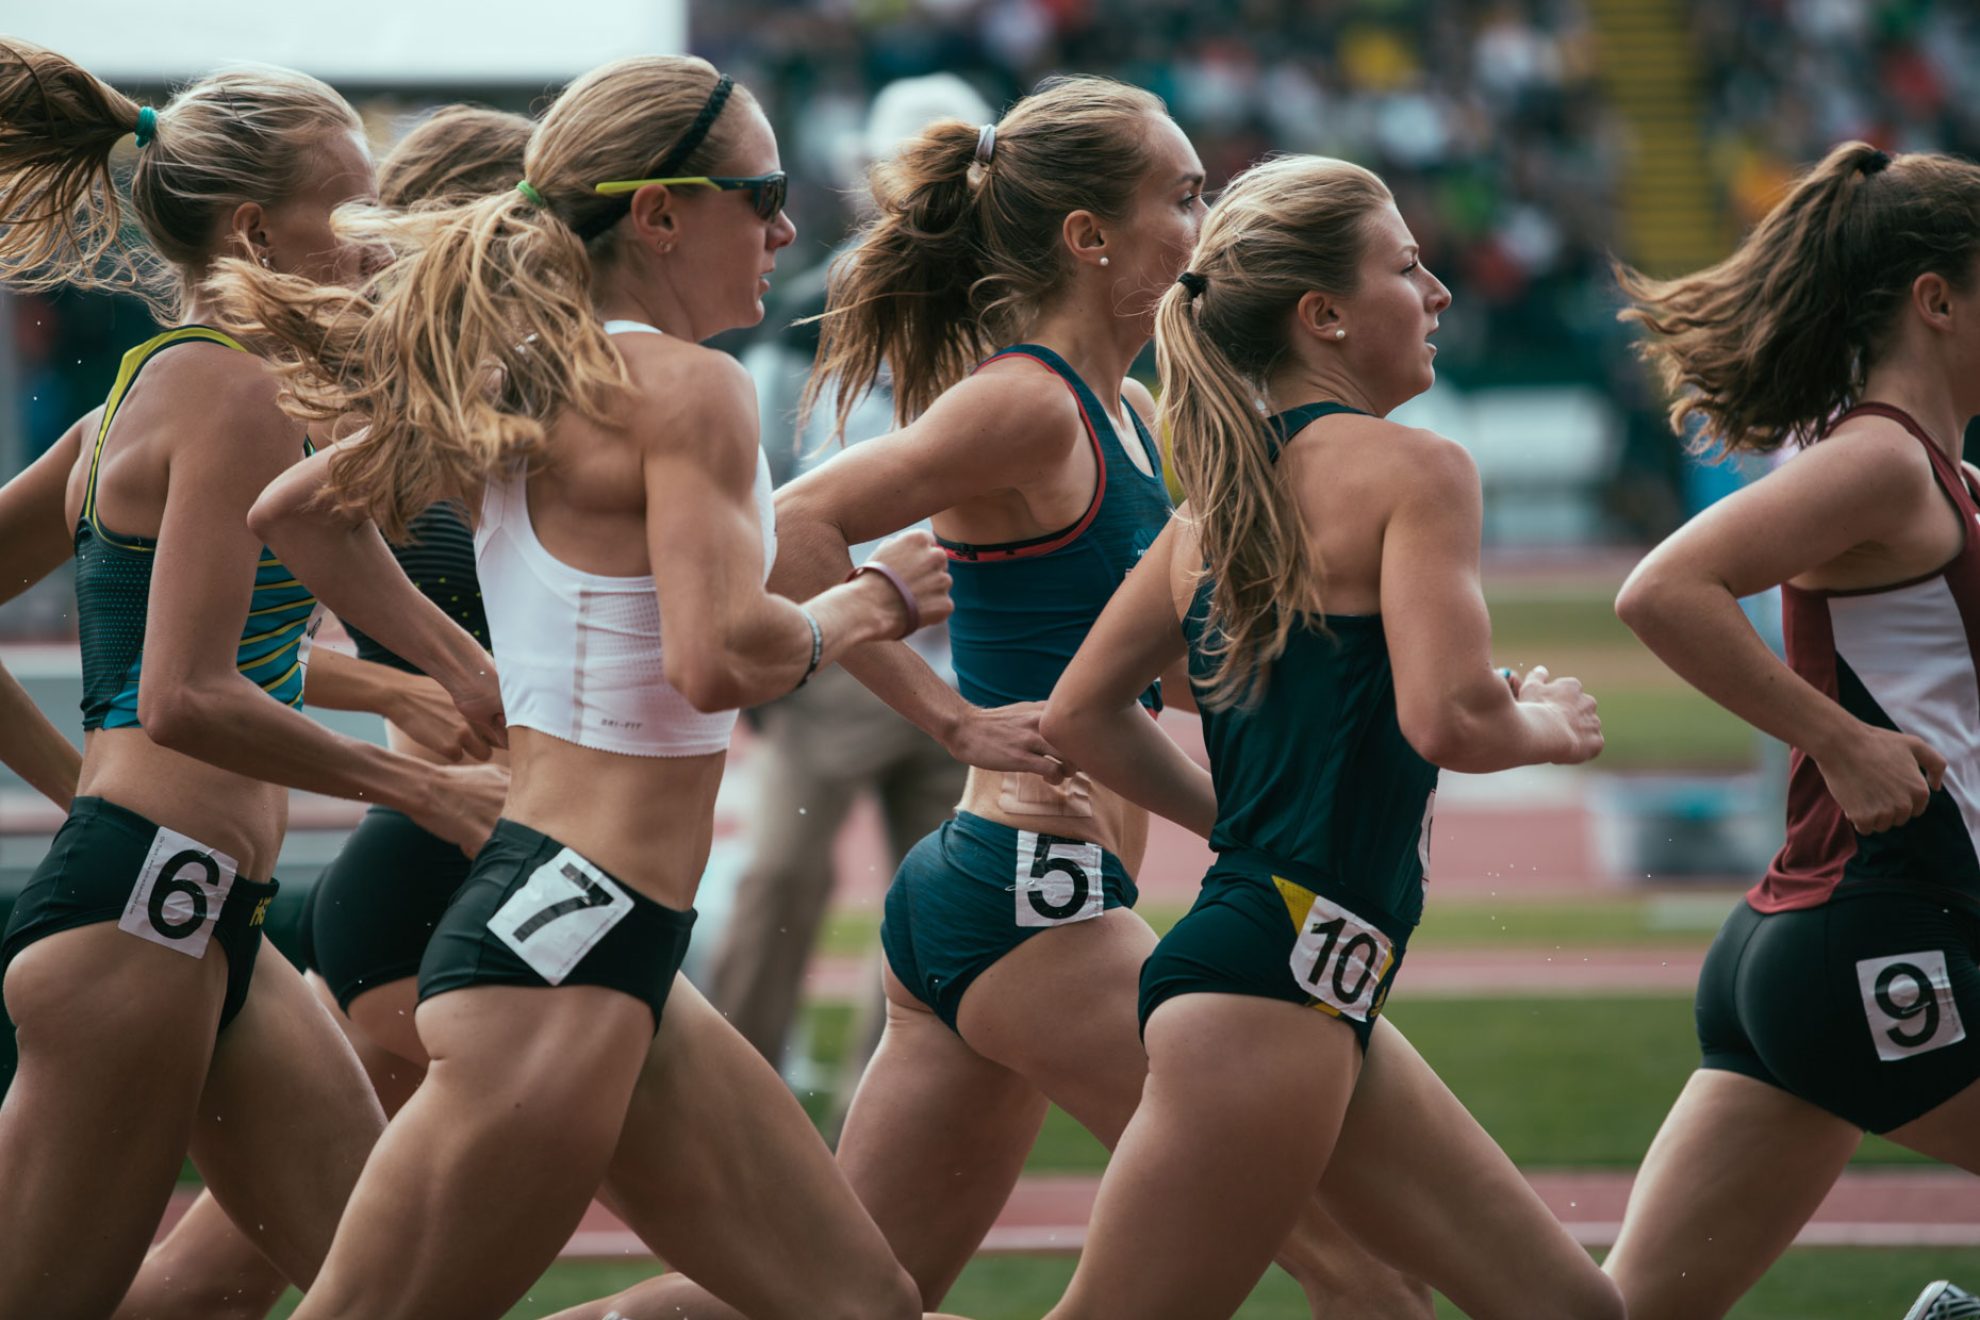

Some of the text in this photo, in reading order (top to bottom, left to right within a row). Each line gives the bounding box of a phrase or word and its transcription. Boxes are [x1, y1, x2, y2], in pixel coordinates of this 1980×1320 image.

[148, 849, 220, 940] 6
[512, 862, 615, 943] 7
[1027, 833, 1089, 919] 5
[1307, 916, 1378, 1004] 10
[1875, 962, 1940, 1048] 9
